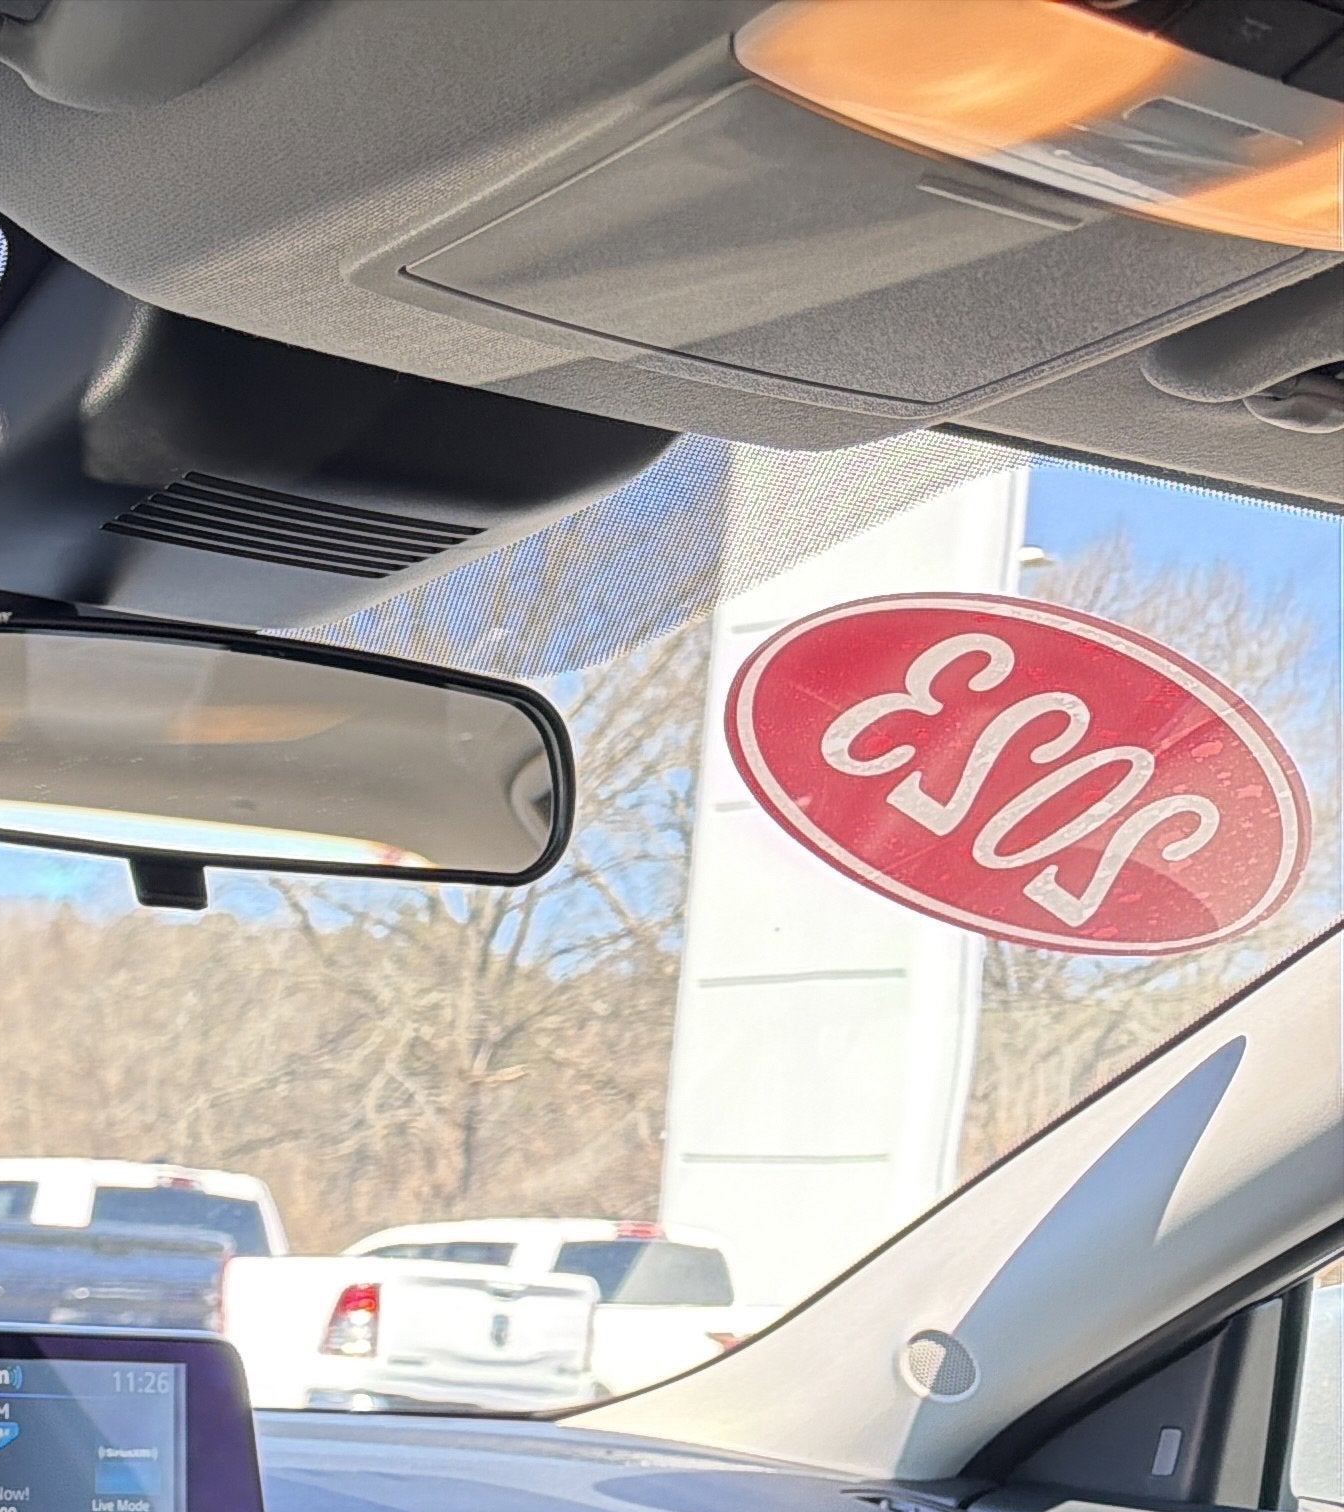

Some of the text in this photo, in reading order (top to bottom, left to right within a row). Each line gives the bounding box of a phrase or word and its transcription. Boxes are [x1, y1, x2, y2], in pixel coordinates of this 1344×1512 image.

[112, 1371, 170, 1394] 11:26
[92, 1500, 151, 1512] Live Mode
